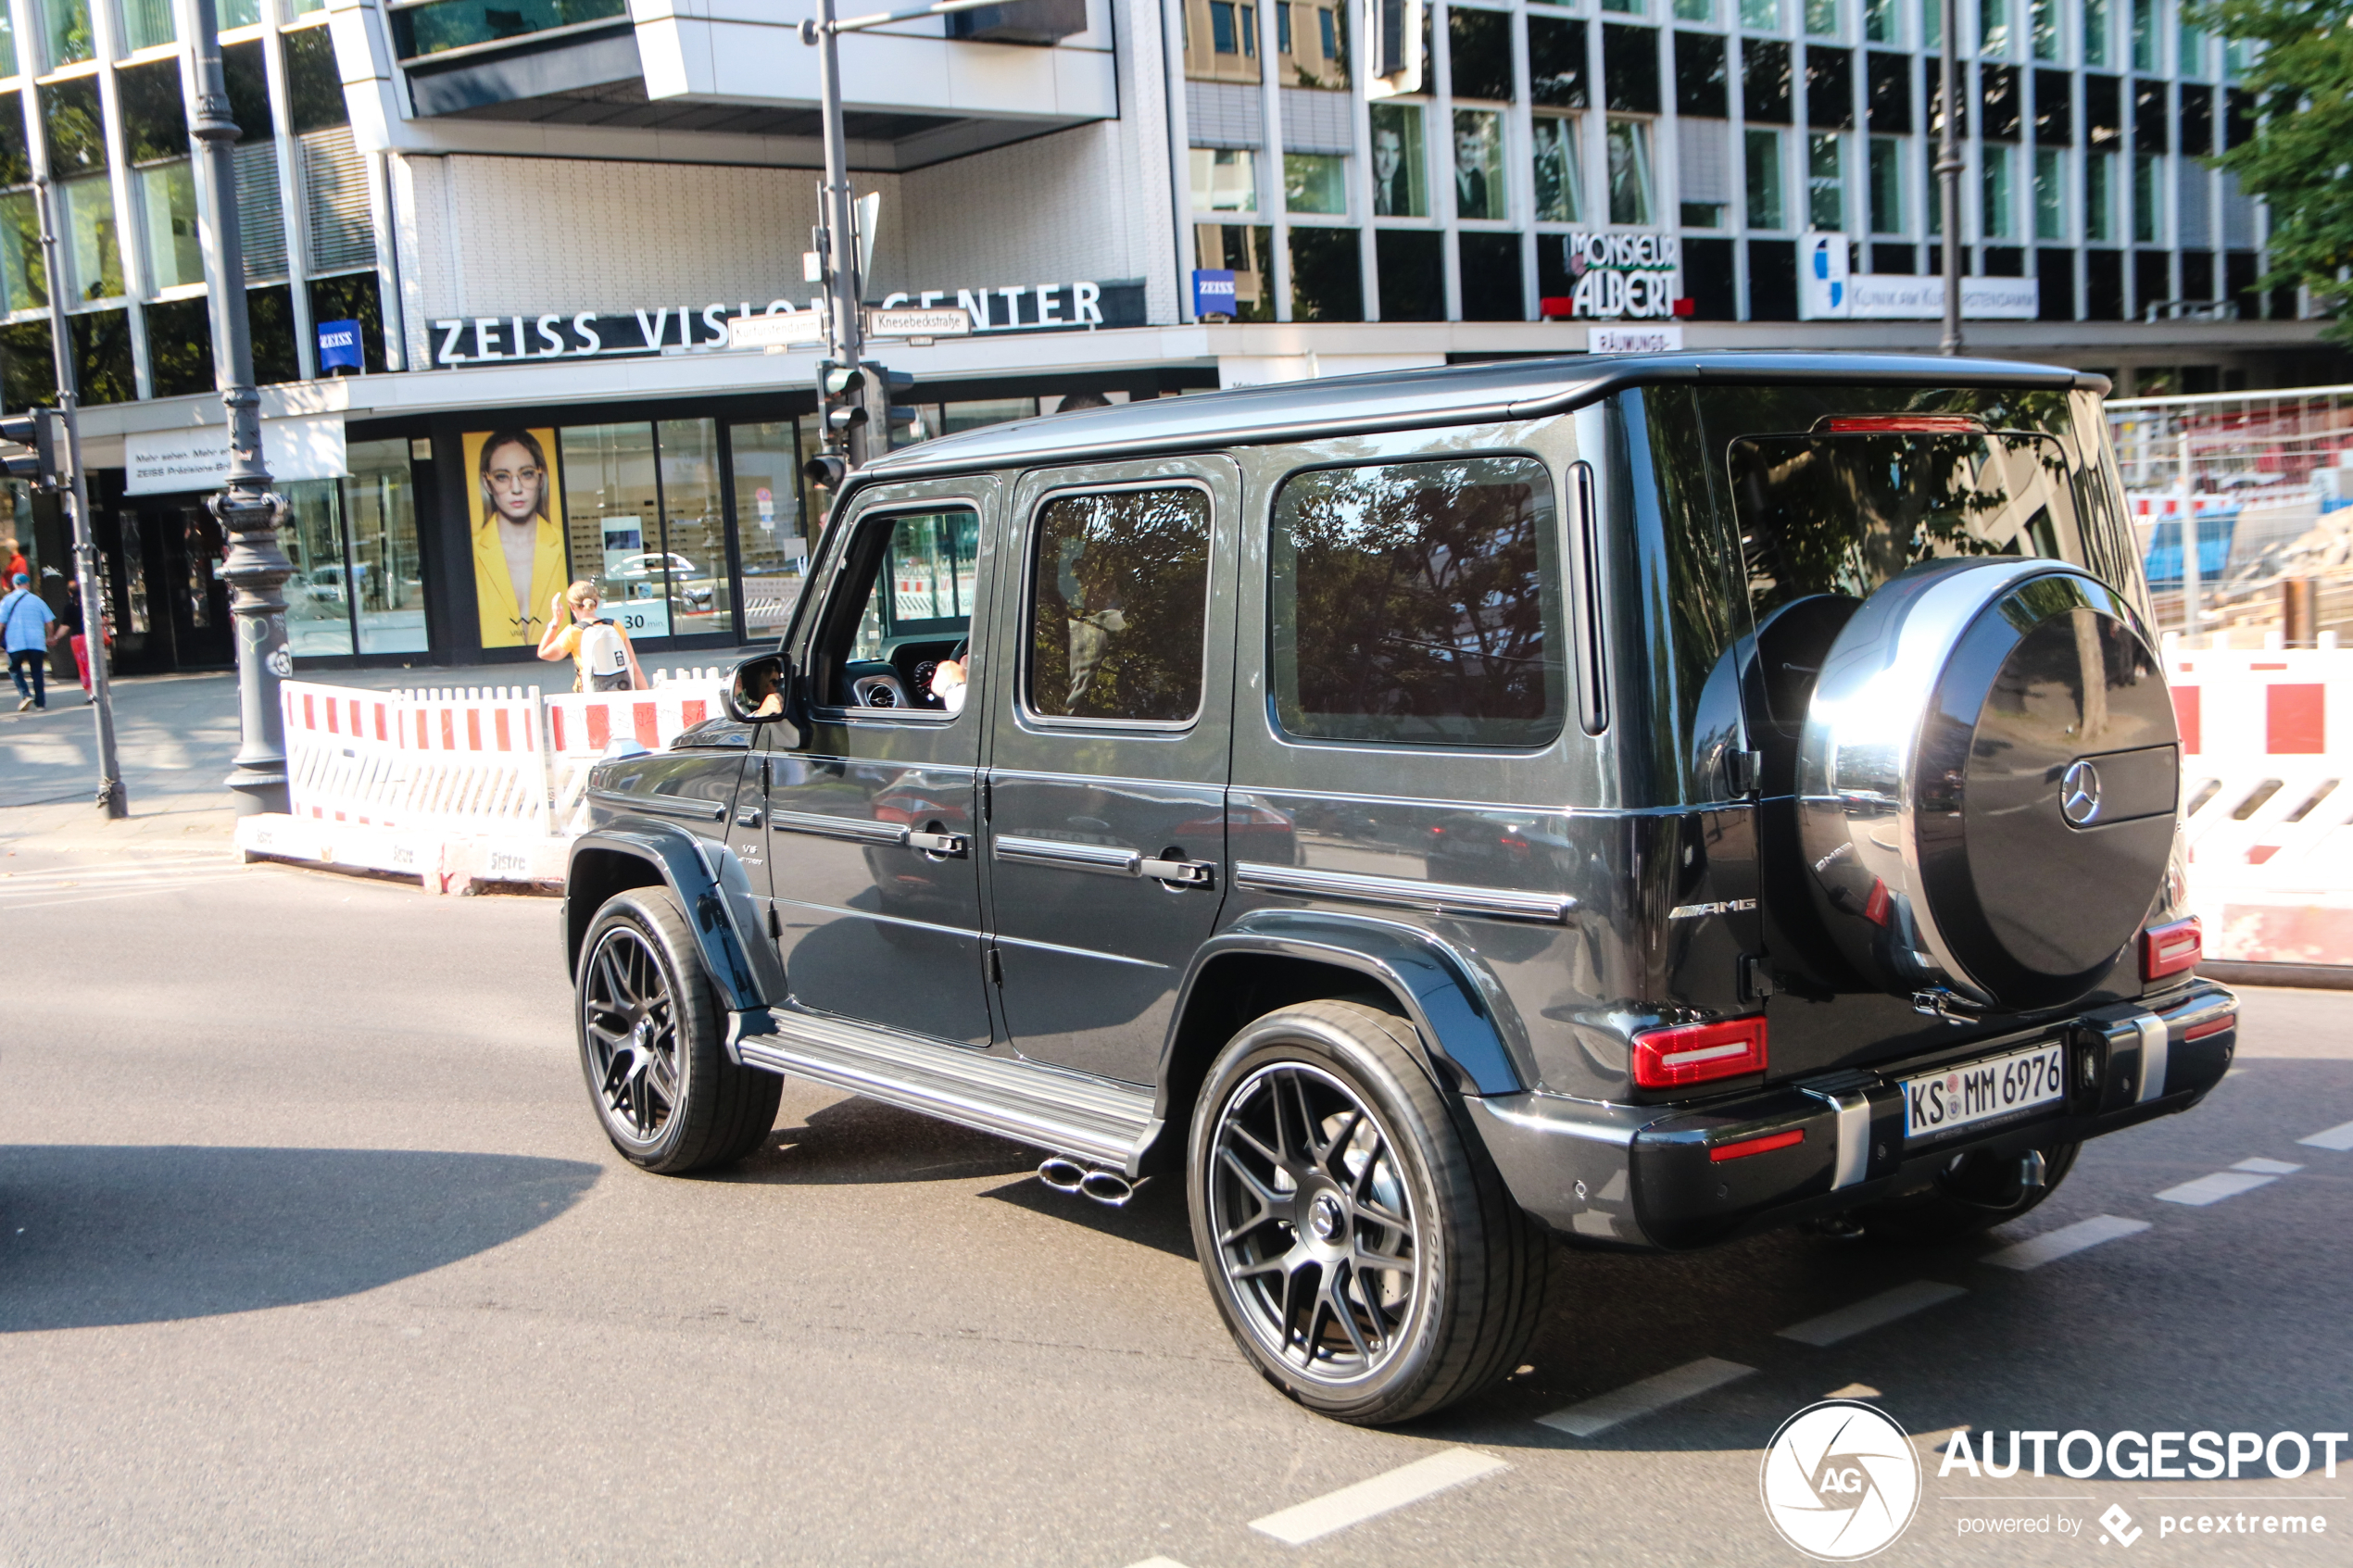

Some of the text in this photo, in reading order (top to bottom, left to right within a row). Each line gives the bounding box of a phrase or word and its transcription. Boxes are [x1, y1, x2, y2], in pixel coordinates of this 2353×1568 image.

[1570, 233, 1677, 267] MONSIEUR
[1200, 281, 1235, 295] ZEISS
[1572, 269, 1677, 317] ALBERT
[435, 311, 601, 364] ZEISS
[635, 297, 824, 351] VIS
[878, 313, 961, 330] Knesebeckstraße
[319, 332, 353, 348] ZEISS
[137, 468, 165, 478] ZEISS
[624, 614, 665, 629] 30 min.
[1692, 898, 1756, 917] AMG
[1911, 1080, 1944, 1129] KS
[1964, 1067, 1995, 1115] MM
[2003, 1051, 2059, 1104] 6976
